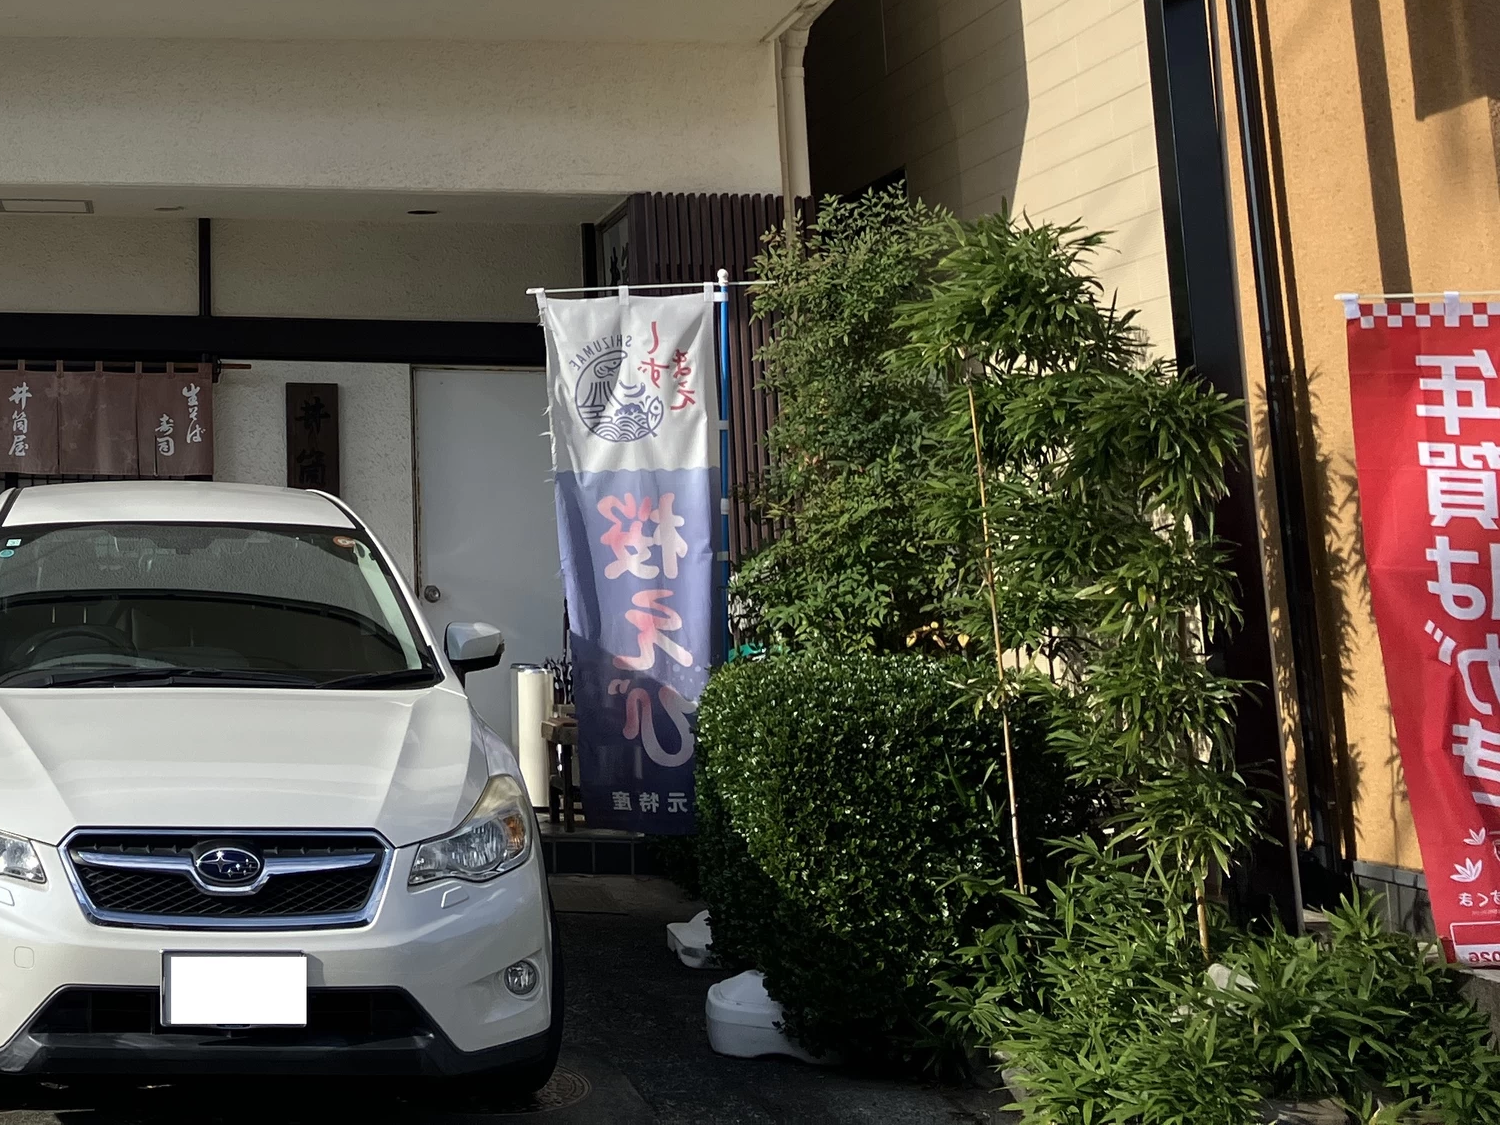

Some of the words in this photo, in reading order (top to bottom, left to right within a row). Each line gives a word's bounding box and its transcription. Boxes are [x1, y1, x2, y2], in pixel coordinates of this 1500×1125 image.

[8, 381, 33, 457] 井筒屋
[182, 383, 206, 444] 生そば
